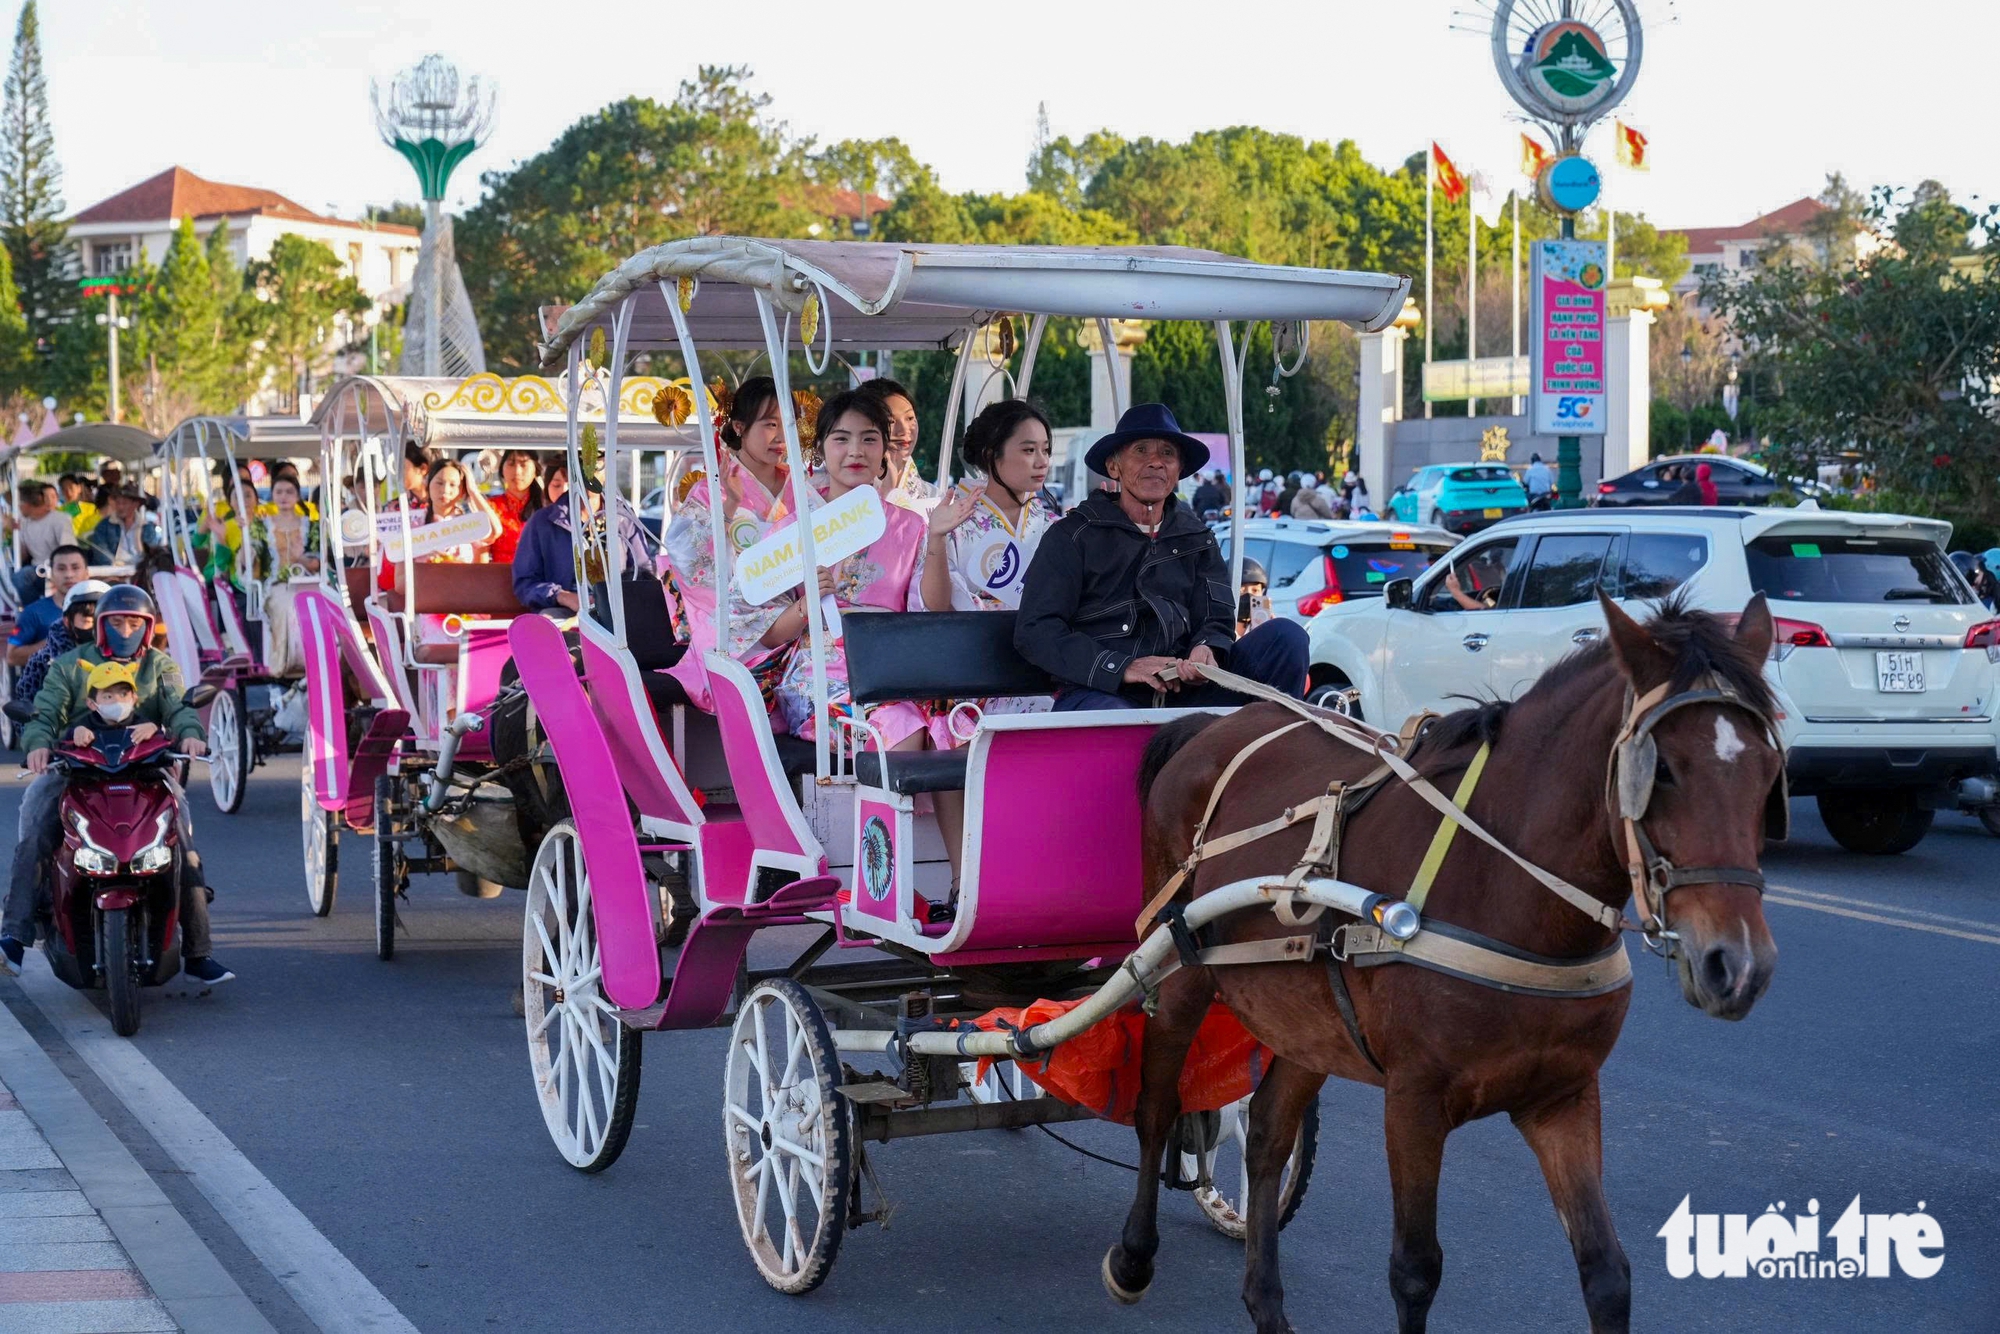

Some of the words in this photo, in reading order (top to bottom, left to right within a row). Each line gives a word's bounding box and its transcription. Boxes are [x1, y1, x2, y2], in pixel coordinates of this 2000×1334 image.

[1556, 396, 1590, 419] 5G
[390, 534, 425, 550] NM
[744, 543, 794, 581] NAM
[812, 500, 874, 544] BANK
[1862, 637, 1943, 646] TERRA
[1889, 654, 1913, 671] 51H
